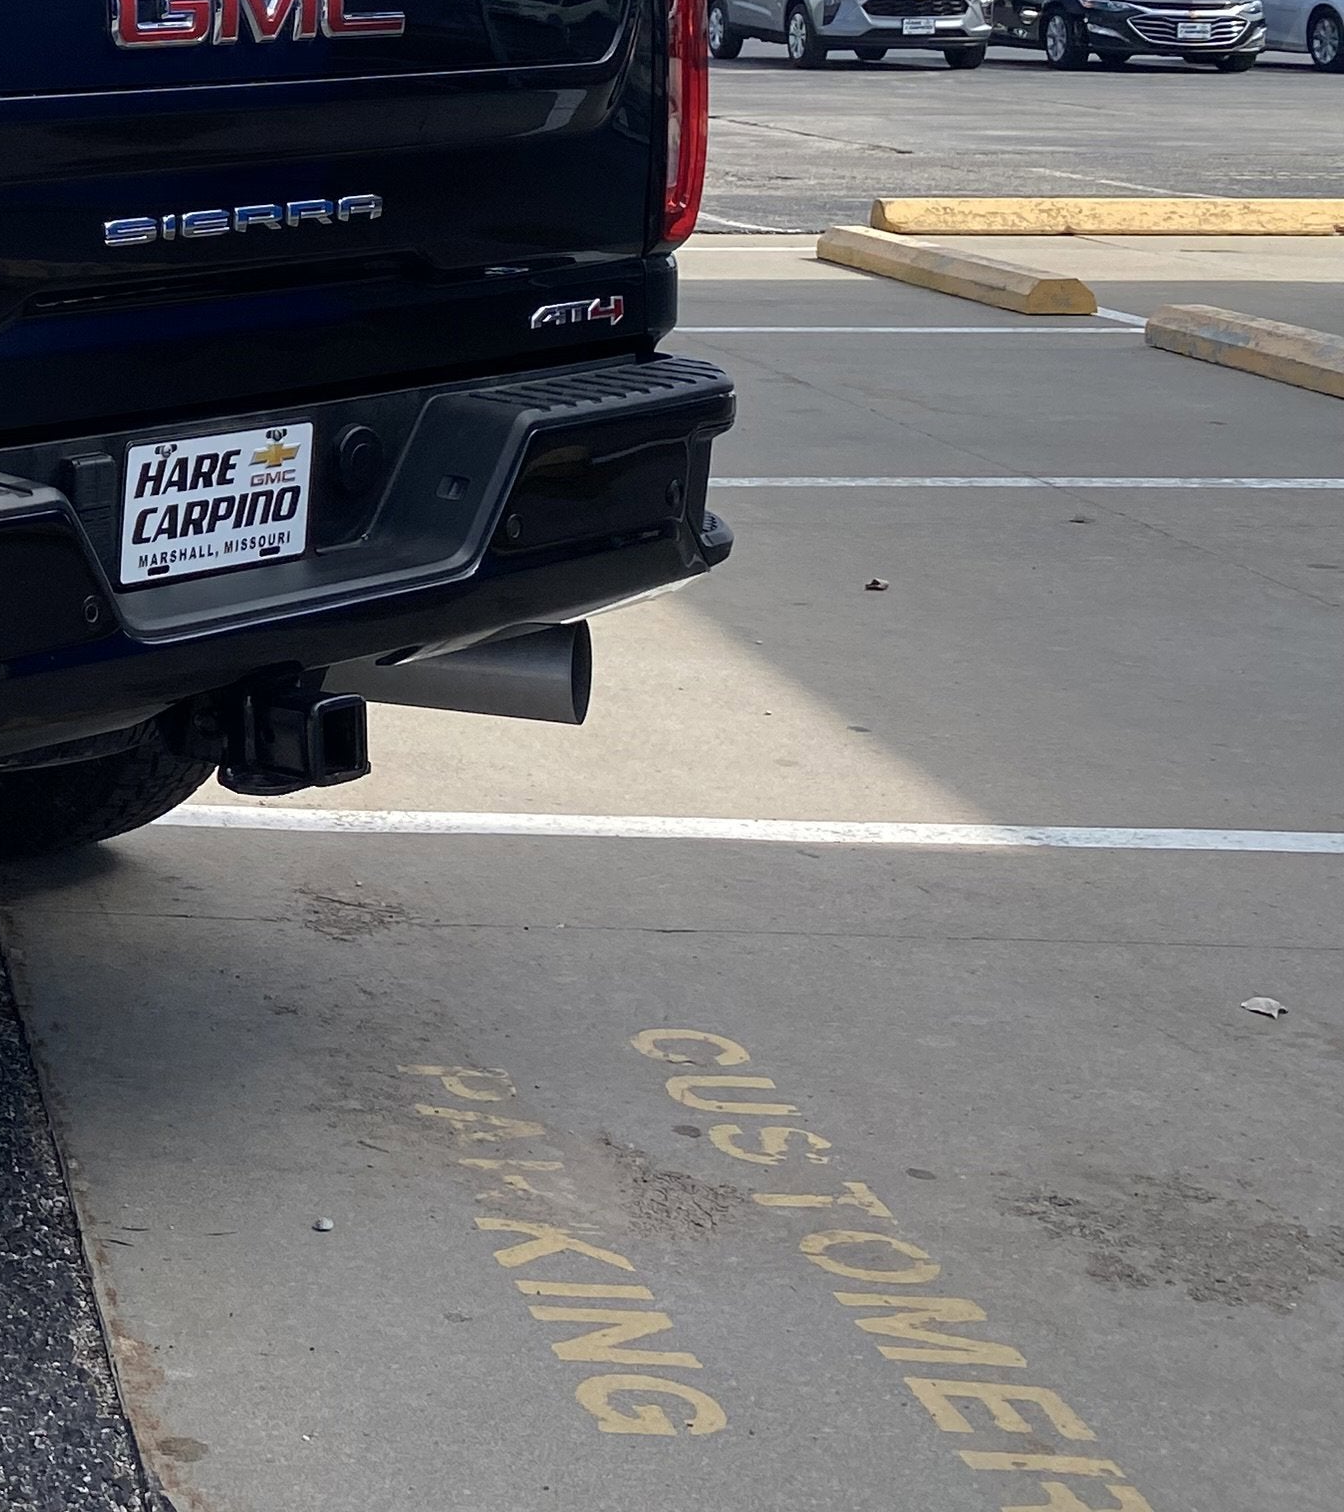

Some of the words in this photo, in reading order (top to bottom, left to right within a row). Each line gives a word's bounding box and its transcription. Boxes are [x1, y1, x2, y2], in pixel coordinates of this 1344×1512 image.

[104, 194, 383, 246] SIERRA
[531, 295, 624, 329] AT4
[134, 449, 242, 499] HARE
[250, 469, 297, 488] GMC
[131, 485, 301, 545] CARPINO
[138, 544, 220, 568] MARSHALL,
[223, 531, 291, 555] MISSOURI
